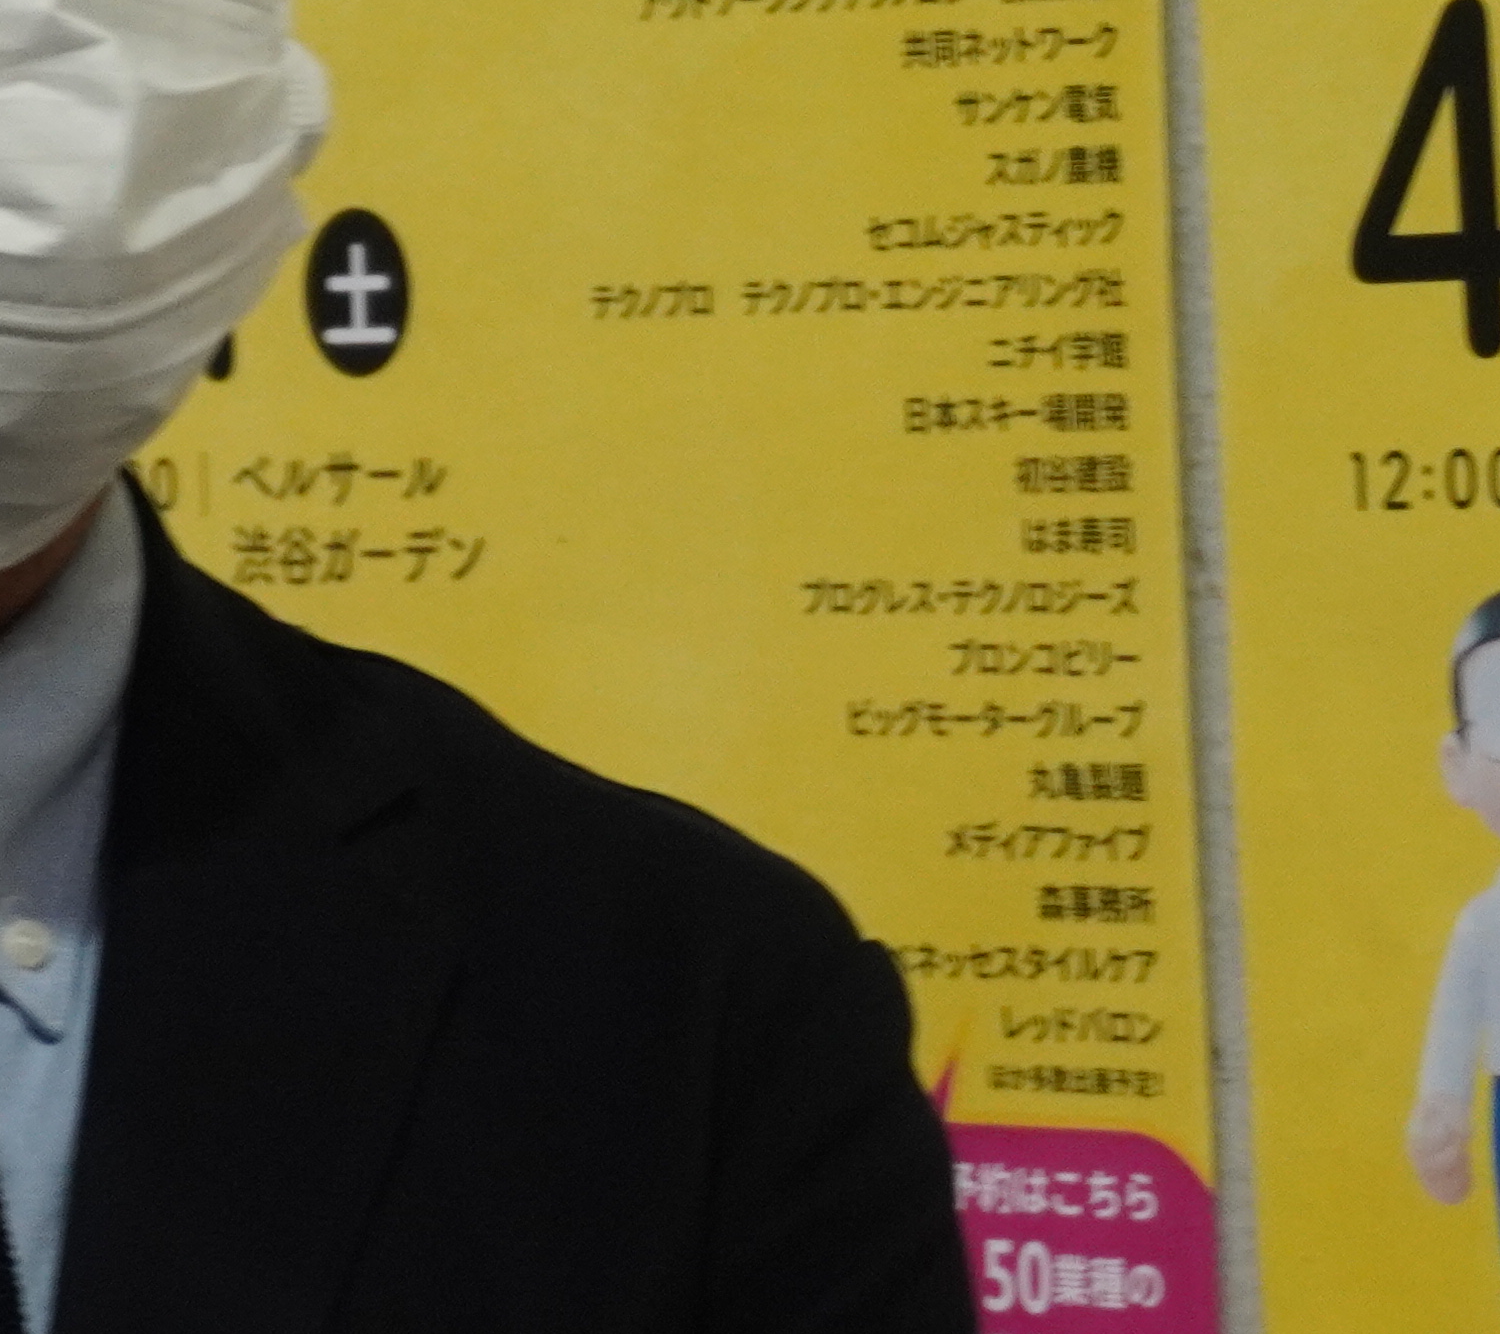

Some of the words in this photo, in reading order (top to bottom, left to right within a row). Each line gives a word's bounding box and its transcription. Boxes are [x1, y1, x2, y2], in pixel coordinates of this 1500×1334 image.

[903, 21, 1118, 68] 共同ネットワーク
[955, 84, 1122, 126] サンケン電気
[322, 243, 398, 345] 土
[591, 282, 713, 319] テクノプロ
[987, 332, 1129, 370] ニチイ学館
[233, 451, 447, 505] ベルサール
[233, 526, 487, 585] 渋谷ガーデン
[1022, 518, 1136, 554] はま寿司
[847, 700, 1147, 737] ビッグモーターグループ
[1000, 1005, 1164, 1044] レッドバロン
